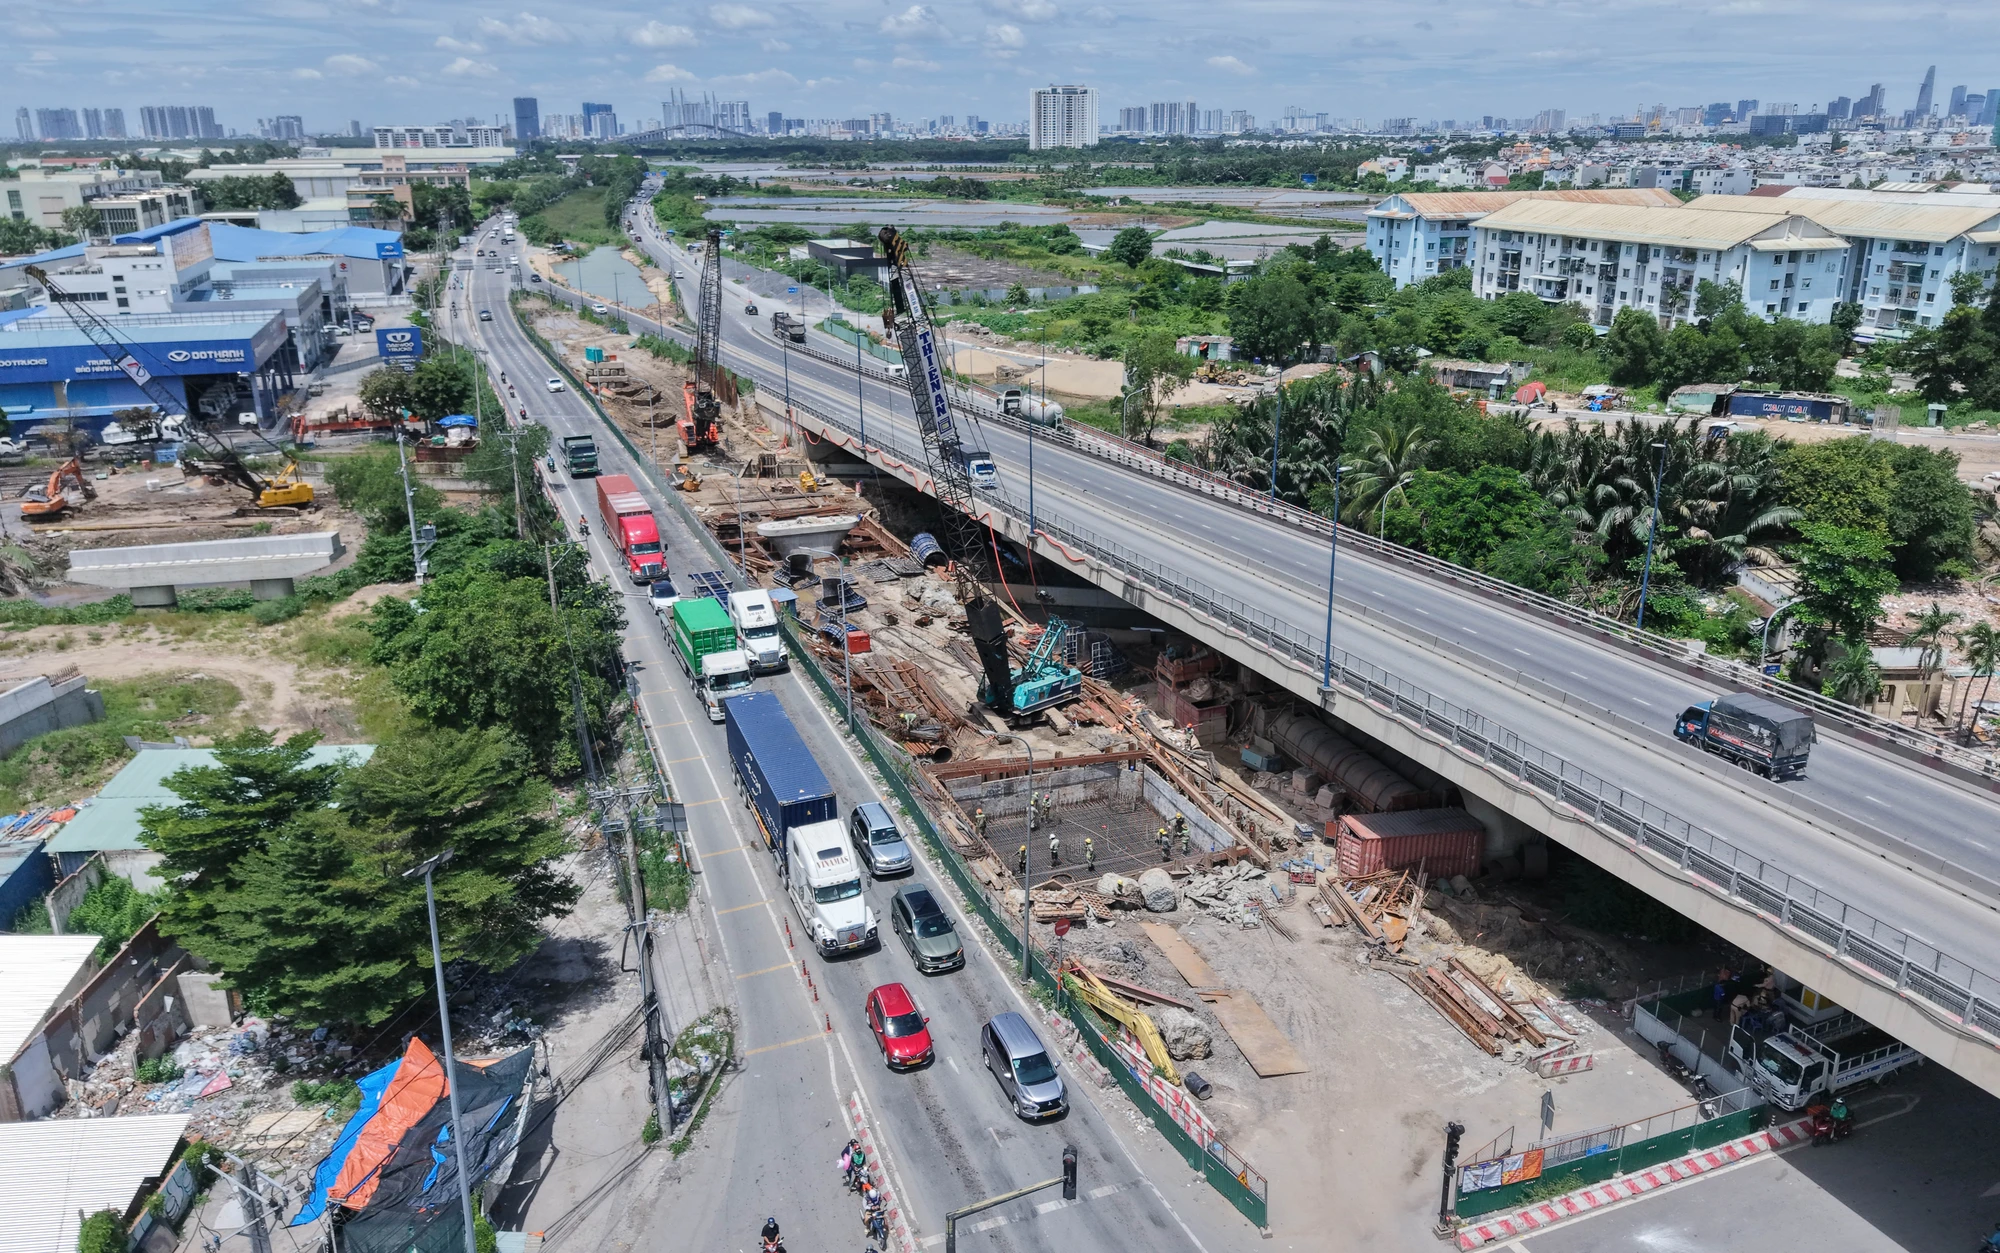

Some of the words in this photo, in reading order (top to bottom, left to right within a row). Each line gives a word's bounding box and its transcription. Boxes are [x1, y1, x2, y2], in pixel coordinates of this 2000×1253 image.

[1825, 262, 1836, 273] A2
[919, 331, 941, 393] THIÊN
[935, 393, 947, 418] AN
[1763, 403, 1785, 412] WAN
[1788, 405, 1808, 414] HAI
[816, 856, 849, 869] VINAMAS
